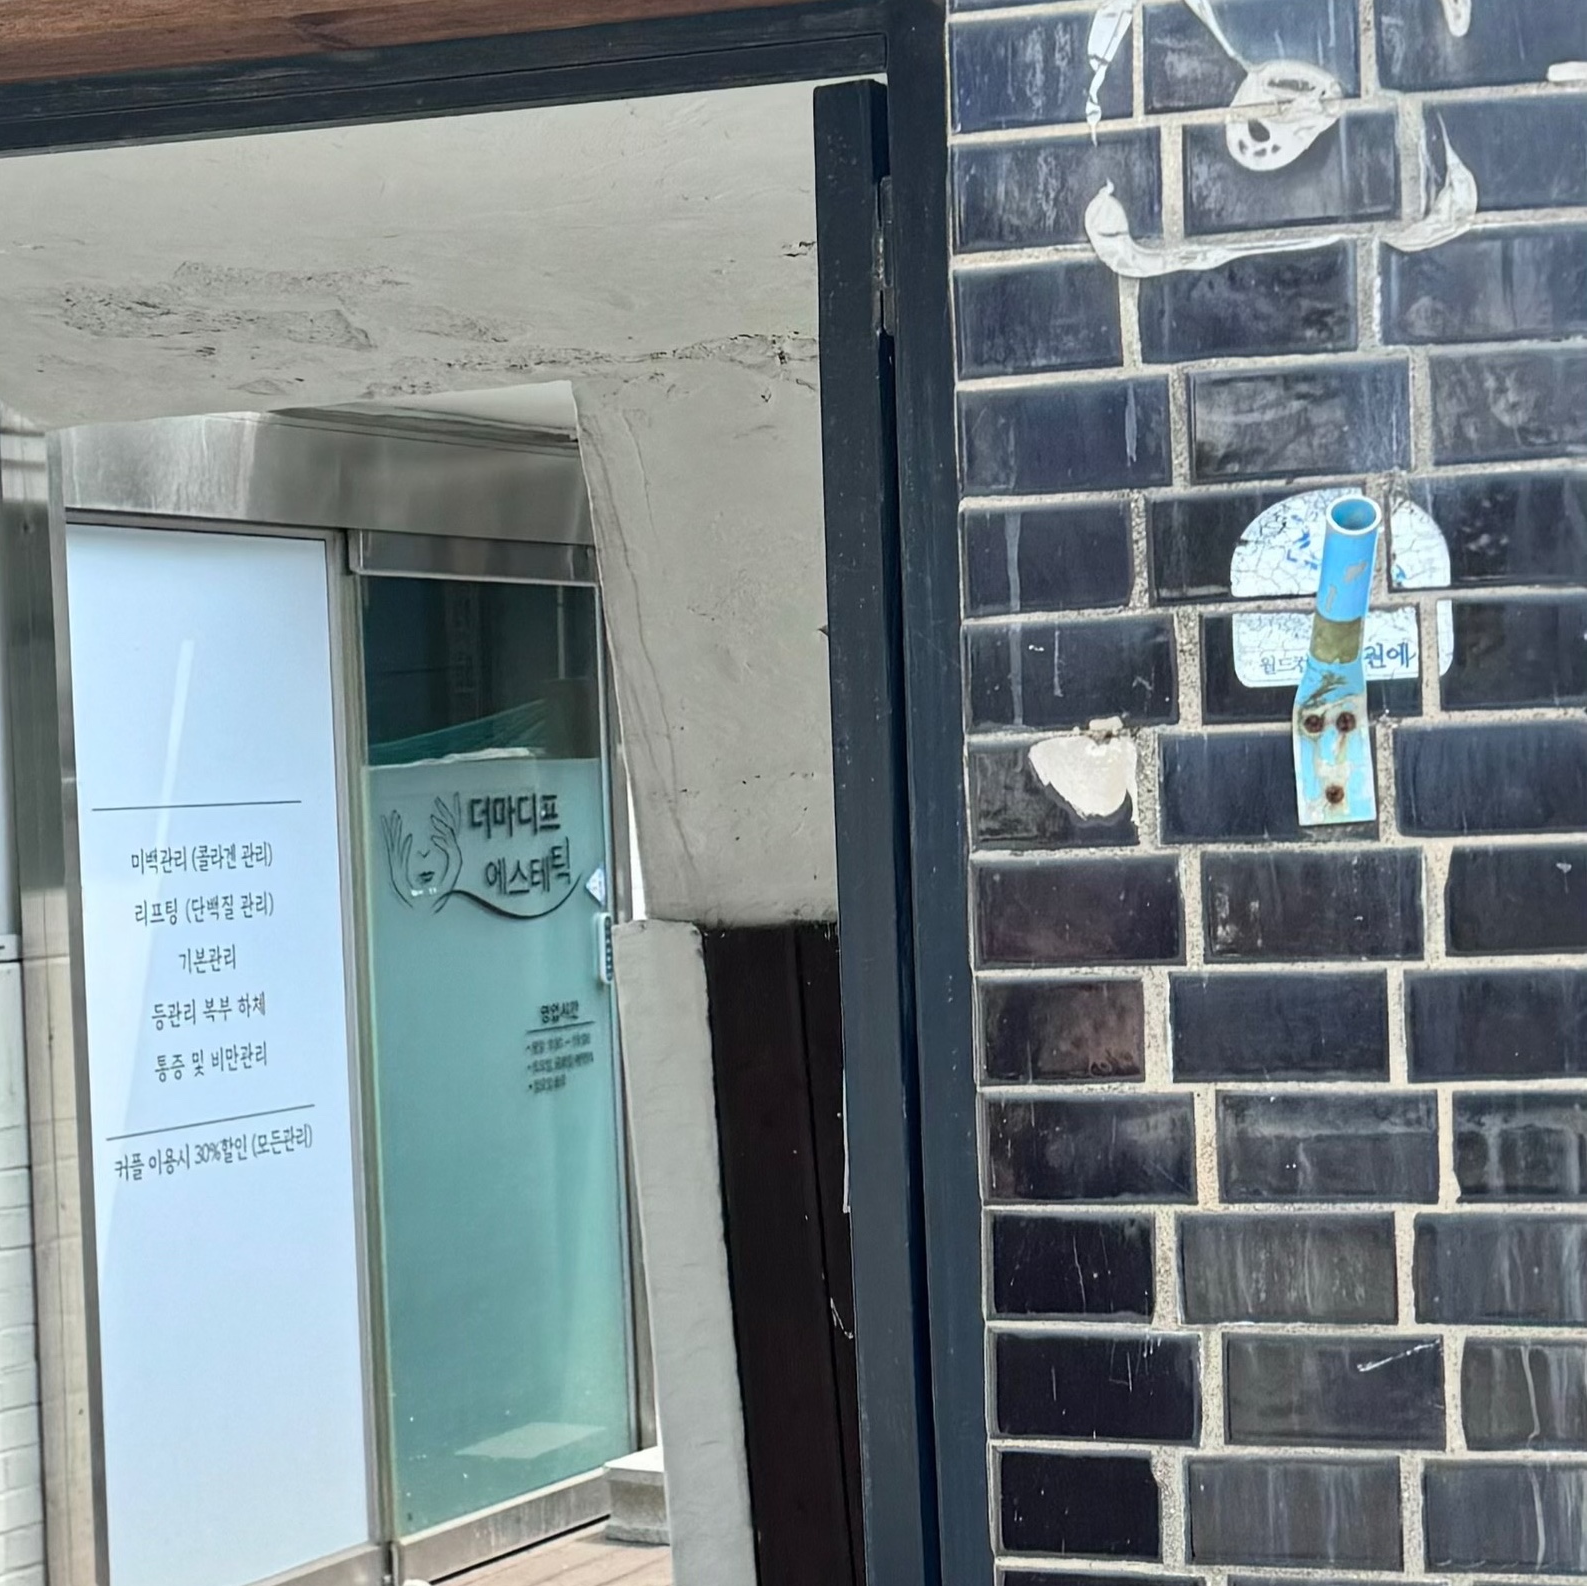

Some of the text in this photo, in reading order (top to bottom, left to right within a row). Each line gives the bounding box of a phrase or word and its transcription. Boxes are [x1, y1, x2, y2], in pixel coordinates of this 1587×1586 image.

[470, 793, 561, 839] 더마디프
[131, 841, 273, 875] 미백관리 (콜라겐 관리)
[485, 836, 571, 895] 에스테틱
[134, 891, 274, 926] 리프팅 (단백질 관리)
[178, 944, 237, 974] 기본관리
[151, 991, 266, 1031] 등관리 복부 하체
[155, 1041, 267, 1082] 통증 및 비만관리
[114, 1124, 313, 1181] 커플 이용시 30%할인 (모든관리)
